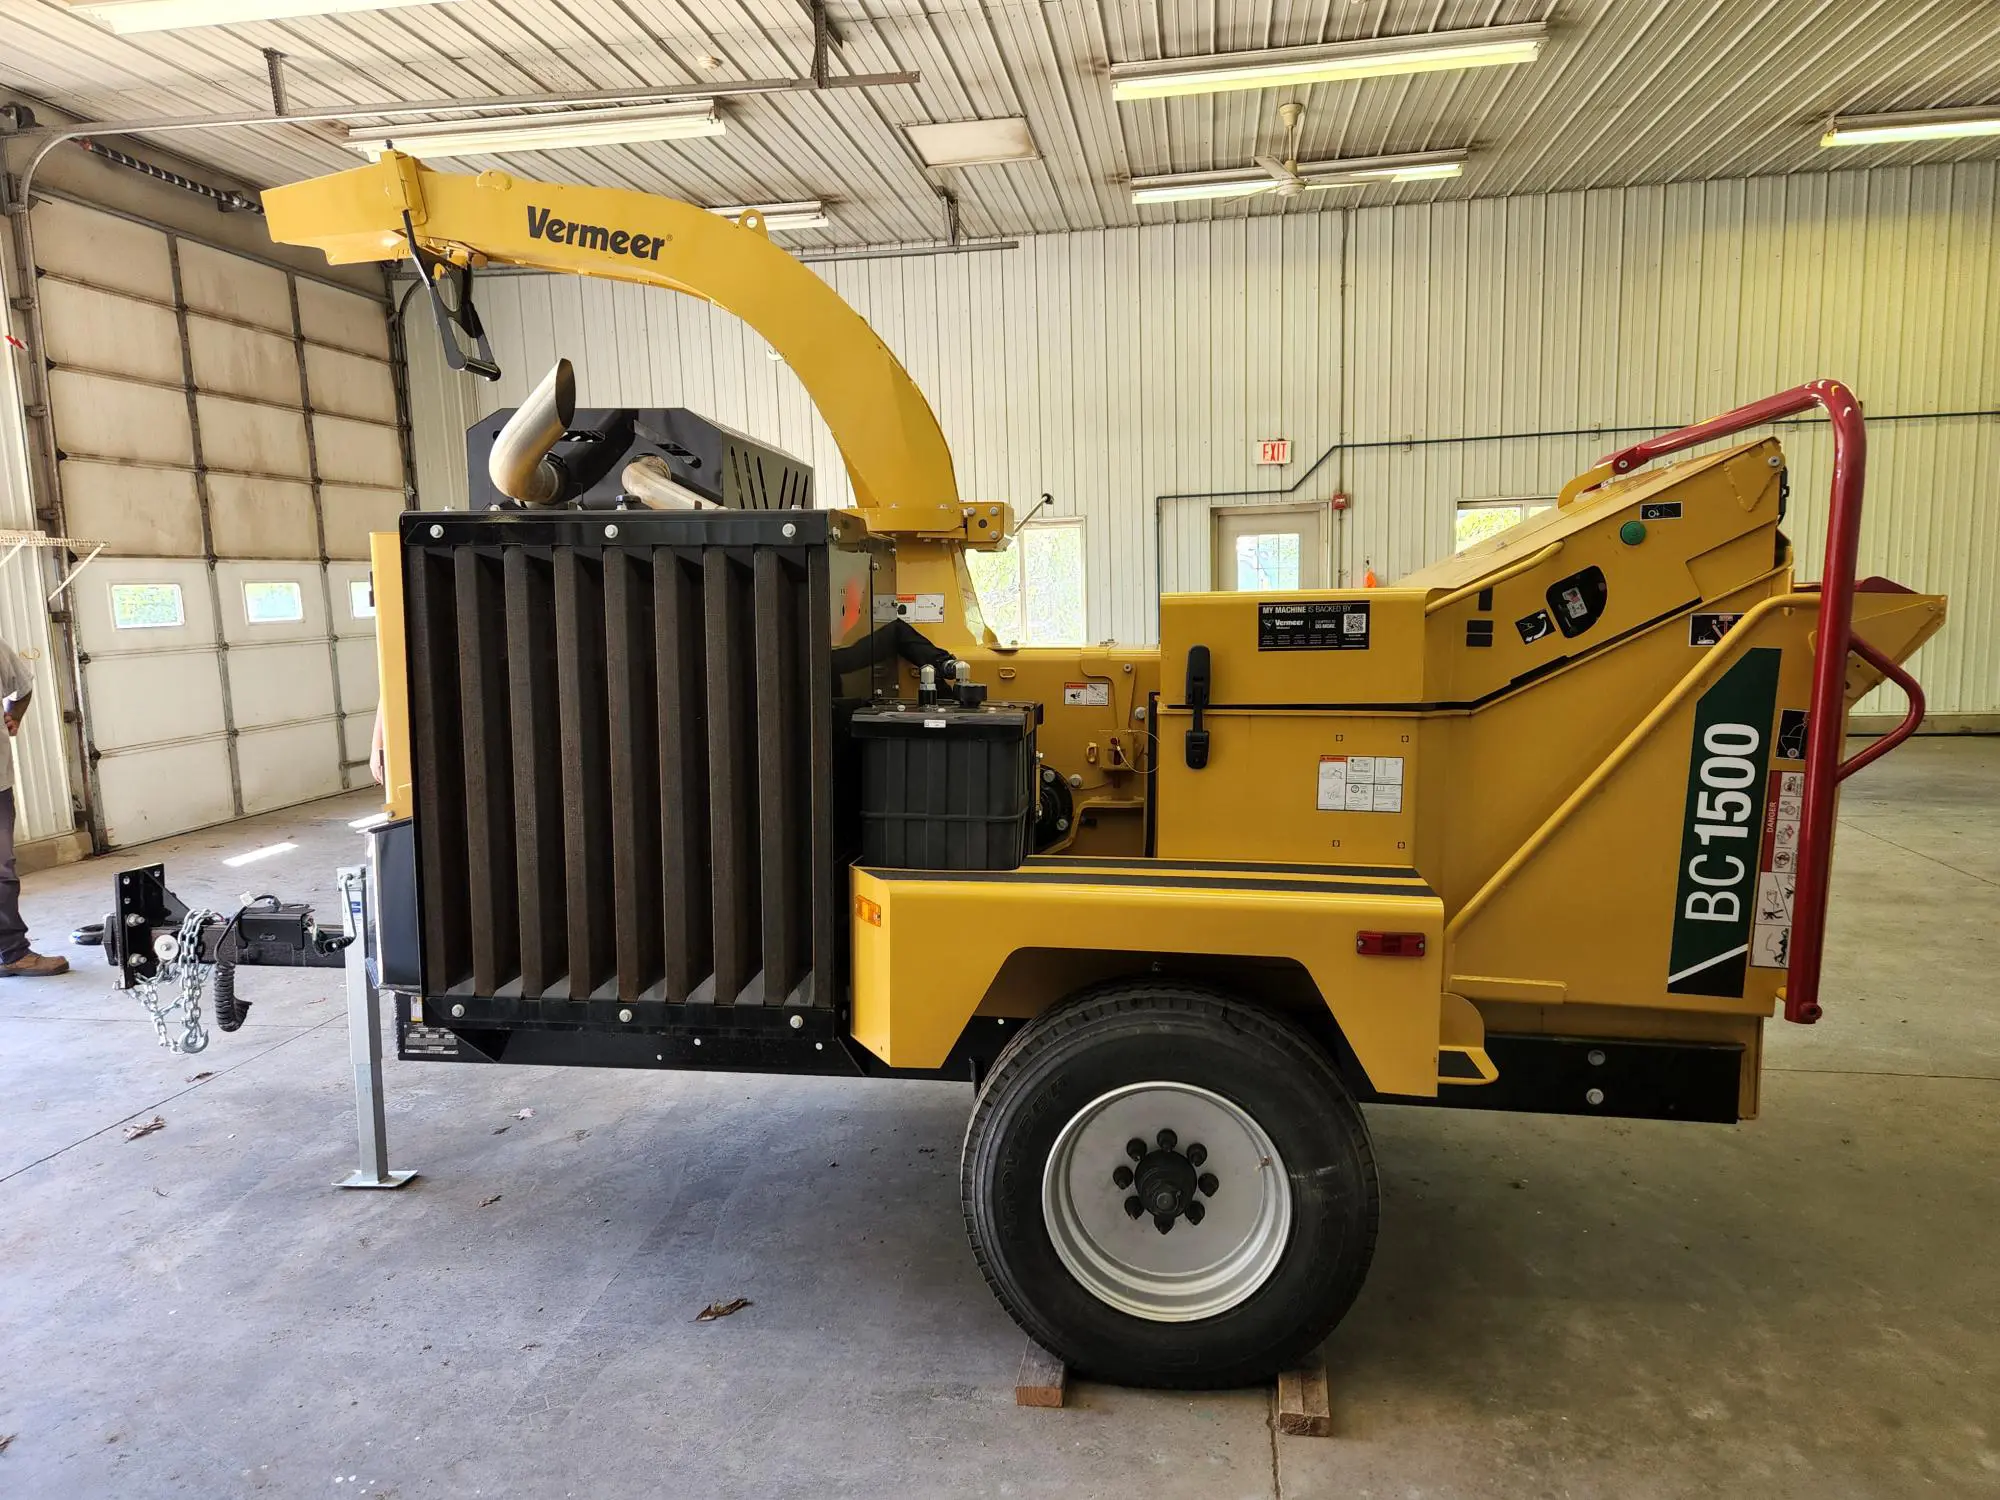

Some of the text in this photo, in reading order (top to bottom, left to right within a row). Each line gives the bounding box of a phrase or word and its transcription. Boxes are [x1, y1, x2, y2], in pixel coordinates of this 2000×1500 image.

[527, 205, 666, 261] Vermeer
[1263, 443, 1287, 461] EXIT
[1766, 801, 1777, 833] DANGER
